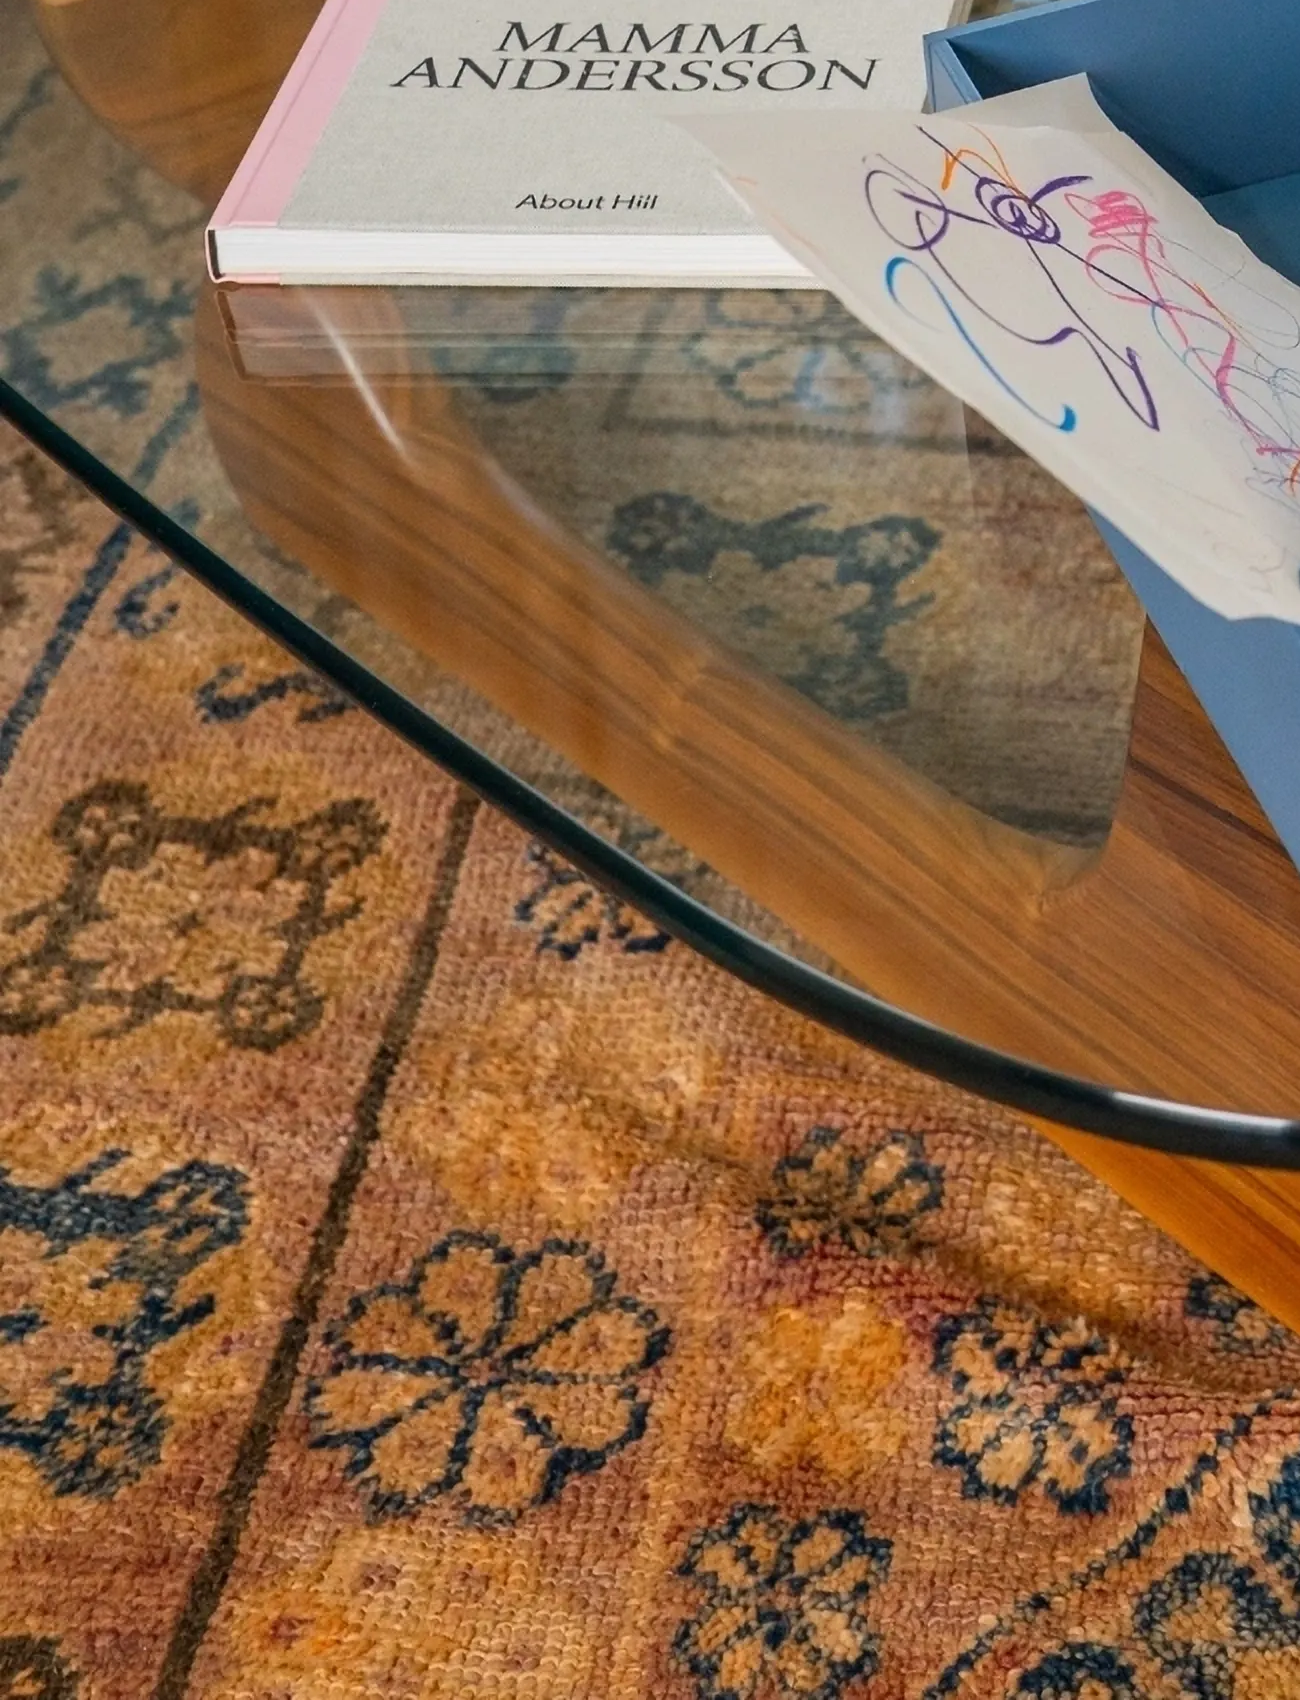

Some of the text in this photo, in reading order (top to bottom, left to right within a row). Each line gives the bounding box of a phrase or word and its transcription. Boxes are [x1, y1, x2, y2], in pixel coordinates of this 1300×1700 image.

[494, 21, 811, 55] MAMMA
[389, 57, 883, 92] ANDERSSON
[515, 193, 659, 211] About Hill
